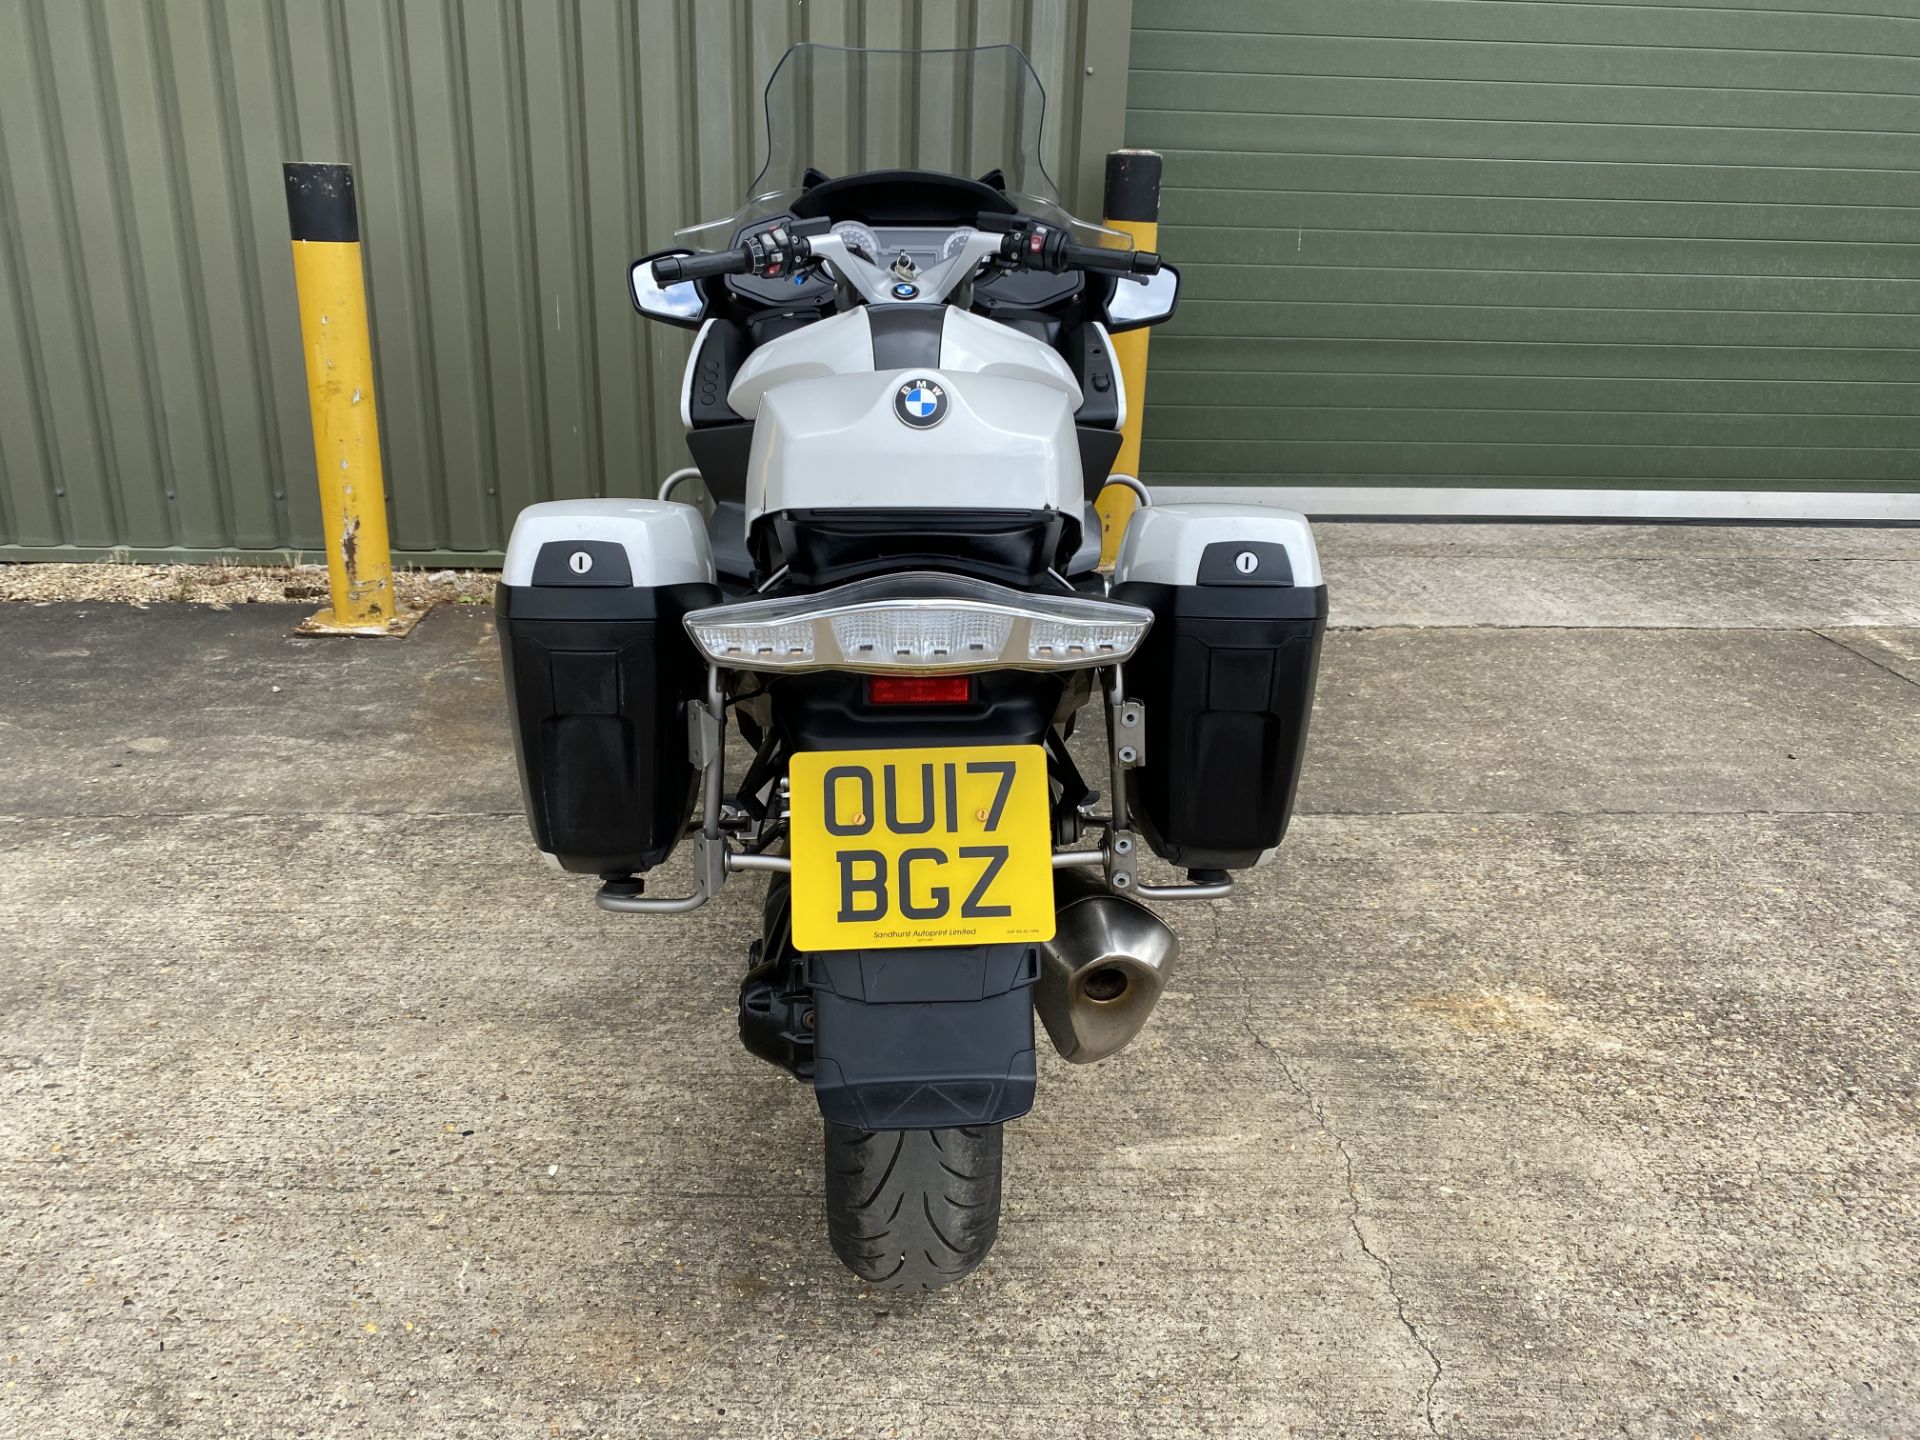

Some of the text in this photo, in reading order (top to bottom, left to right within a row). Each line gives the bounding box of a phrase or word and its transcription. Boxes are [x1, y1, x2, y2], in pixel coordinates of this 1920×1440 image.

[900, 380, 943, 396] BMW
[823, 761, 1017, 836] OU17
[836, 845, 1012, 923] BGZ
[873, 928, 976, 939] Sandhurst Autoprint Limited
